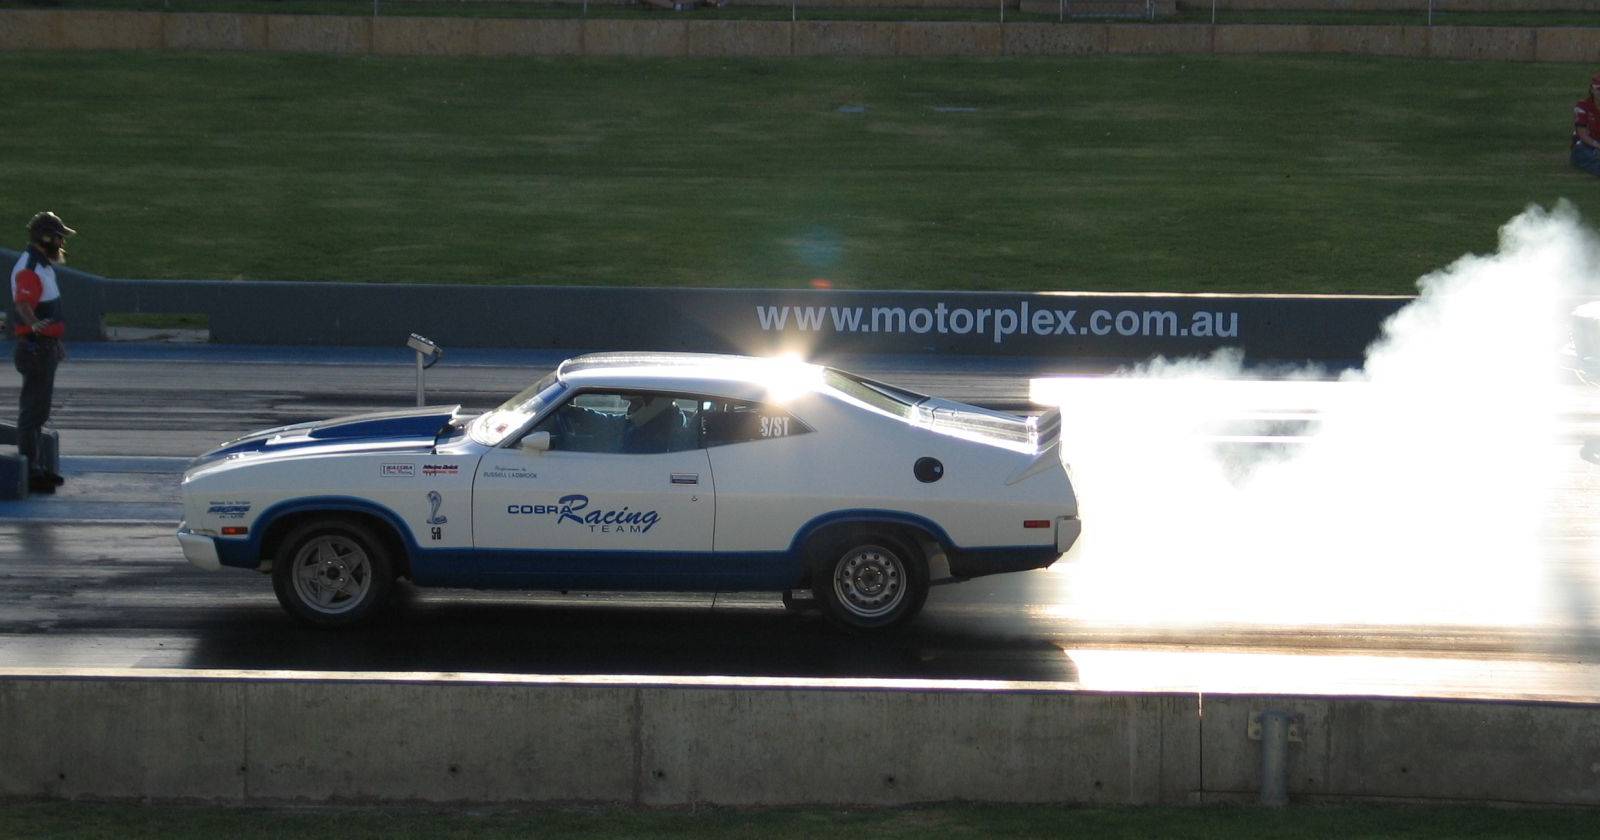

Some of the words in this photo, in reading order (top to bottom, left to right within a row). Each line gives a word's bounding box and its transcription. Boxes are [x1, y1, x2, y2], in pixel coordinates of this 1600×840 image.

[757, 301, 1239, 343] www.motorplex.com.au
[761, 416, 790, 437] S/ST
[507, 504, 572, 514] COBRA
[558, 494, 661, 533] Racing
[588, 525, 641, 533] TEAM
